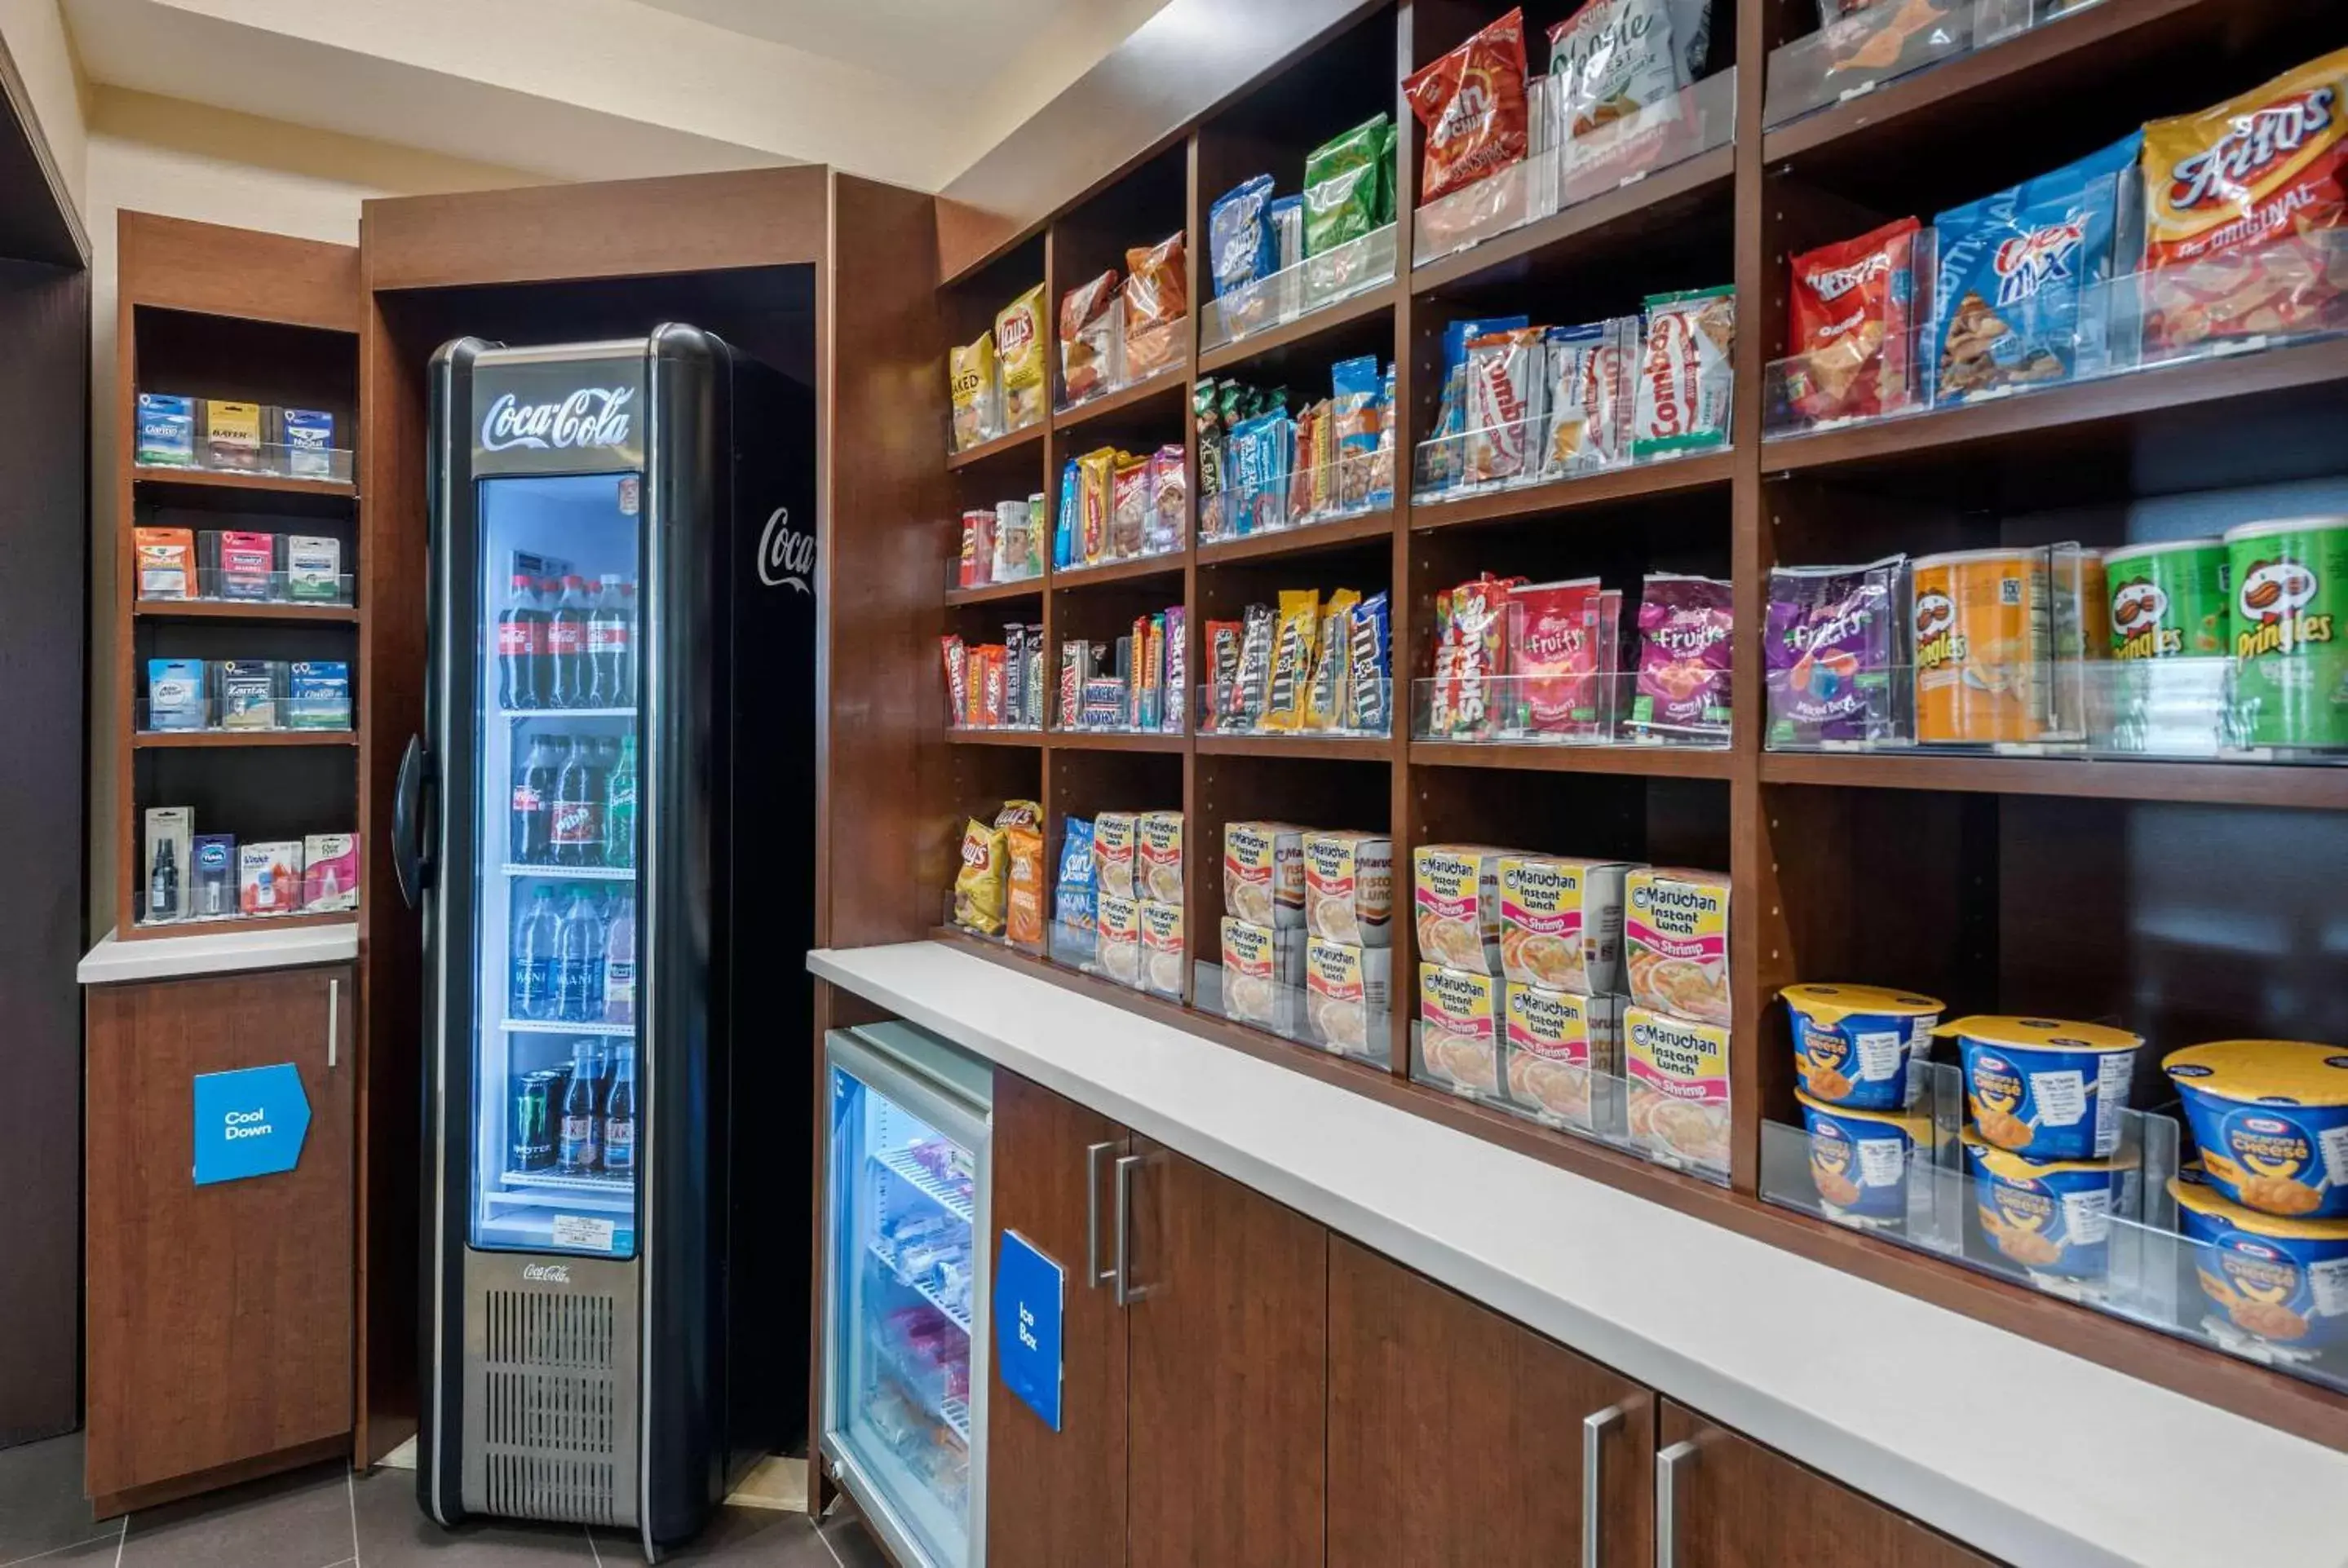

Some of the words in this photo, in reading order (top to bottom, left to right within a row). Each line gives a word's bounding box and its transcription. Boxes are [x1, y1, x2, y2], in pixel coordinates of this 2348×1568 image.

[2169, 87, 2334, 210] Fritos
[2211, 183, 2316, 248] ORIGINAL
[952, 374, 979, 393] AKED
[1643, 319, 1681, 438] Combos
[481, 386, 635, 452] Coca-Cola
[2237, 610, 2333, 673] Pringles
[1428, 858, 1473, 877] Maruchan
[1430, 875, 1461, 887] Instant
[1516, 869, 1576, 890] Maruchan
[1434, 885, 1458, 897] Lunch
[1519, 887, 1560, 901] Instant
[1646, 887, 1717, 912] Maruchan
[1523, 898, 1556, 912] Lunch
[1651, 905, 1699, 923] Instant
[1528, 917, 1565, 931] Shrimp
[1656, 917, 1693, 934] Lunch
[1660, 939, 1704, 956] Shrimp
[1434, 974, 1485, 999] Maruchan
[1437, 991, 1473, 1007] Instant
[1442, 1002, 1470, 1016] Lunch
[1523, 994, 1579, 1020] Maruchan
[1525, 1010, 1565, 1030] Instant
[1530, 1024, 1562, 1040] Lunch
[1646, 1026, 1718, 1056] Maruchan
[1535, 1045, 1572, 1060] Shrimp
[1651, 1043, 1699, 1066] Instant
[1656, 1055, 1695, 1076] Lunch
[1662, 1076, 1707, 1097] Shrimp
[225, 1107, 264, 1124] Cool
[225, 1124, 272, 1140] Down
[2232, 1137, 2308, 1159] Cheese
[1019, 1301, 1034, 1327] Ice
[1019, 1321, 1037, 1352] Box
